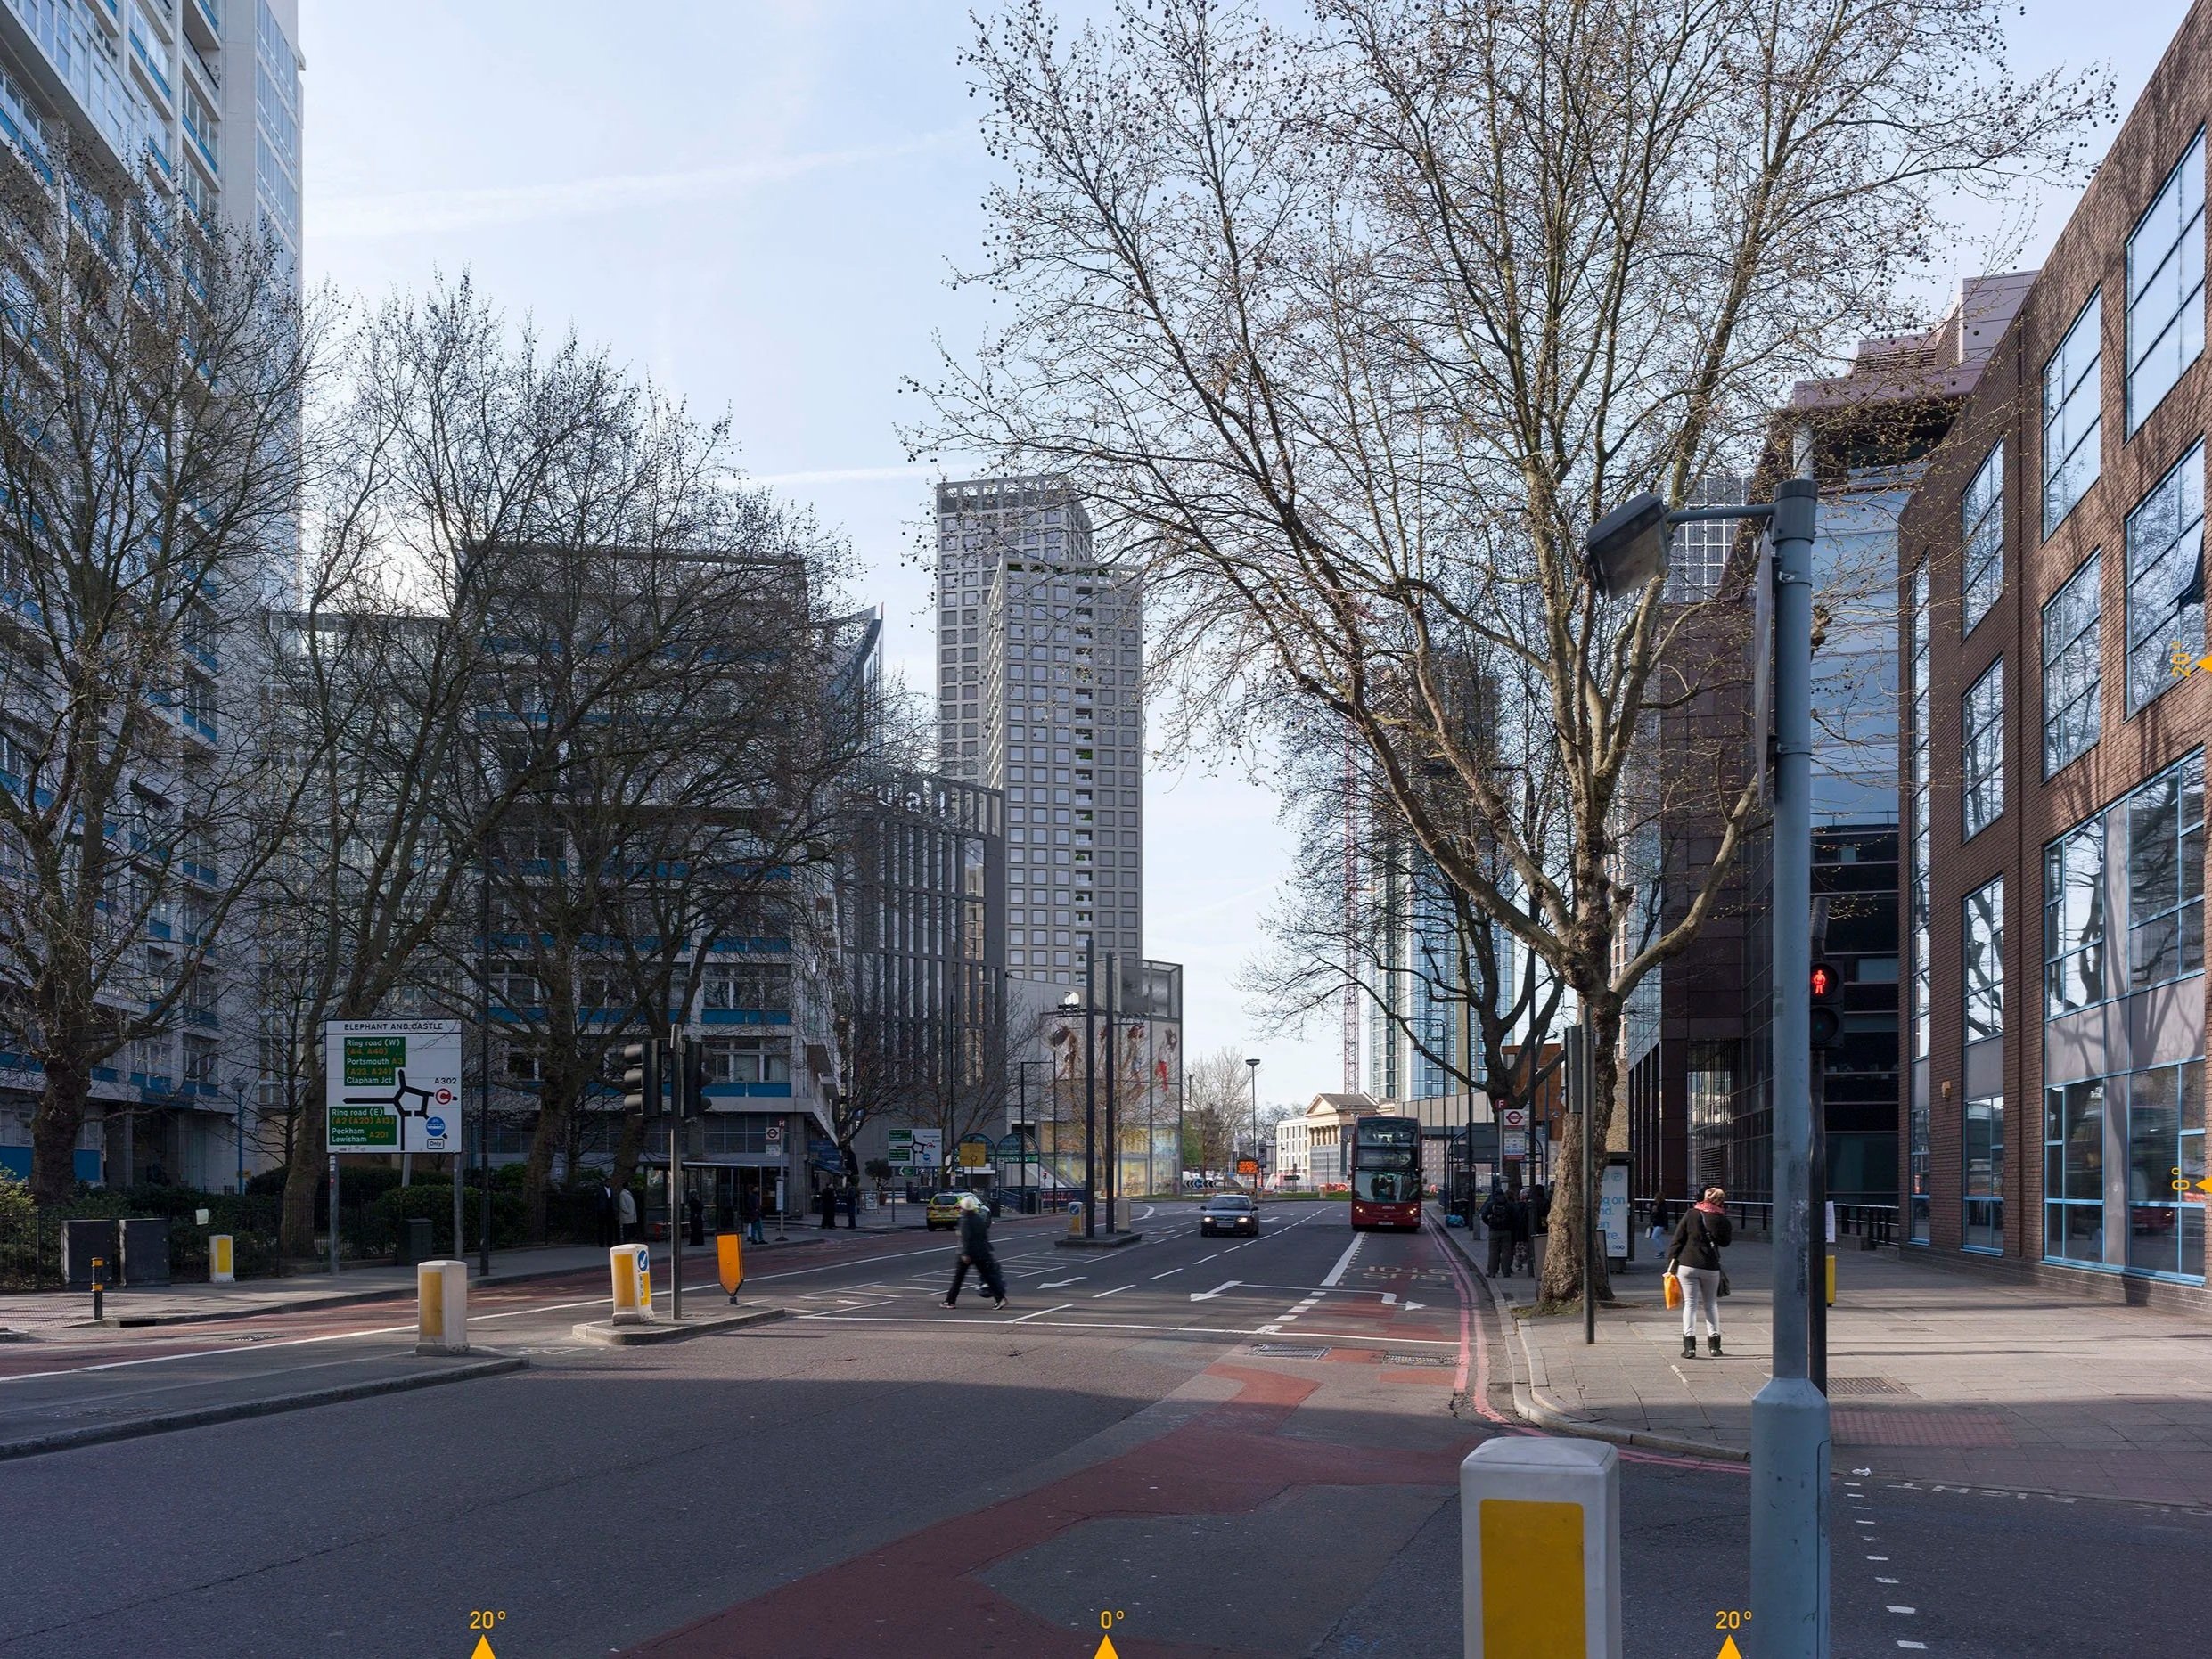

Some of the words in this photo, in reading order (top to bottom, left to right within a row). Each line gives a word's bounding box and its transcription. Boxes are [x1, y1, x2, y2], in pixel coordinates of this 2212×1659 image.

[344, 1023, 389, 1031] ELEPHANT
[411, 1022, 443, 1030] CASTLE
[347, 1039, 363, 1047] Ring
[365, 1039, 382, 1047] road
[384, 1038, 400, 1047] (W)
[347, 1058, 389, 1066] Portsmouth
[392, 1057, 403, 1065] A3
[346, 1076, 379, 1084] Clapham
[381, 1076, 392, 1084] Jct
[1498, 1099, 1504, 1108] F
[332, 1108, 348, 1116] Ring
[349, 1108, 367, 1116] road
[369, 1107, 383, 1116] (E)
[332, 1135, 367, 1143] Lewisham
[1611, 1197, 1625, 1205] on
